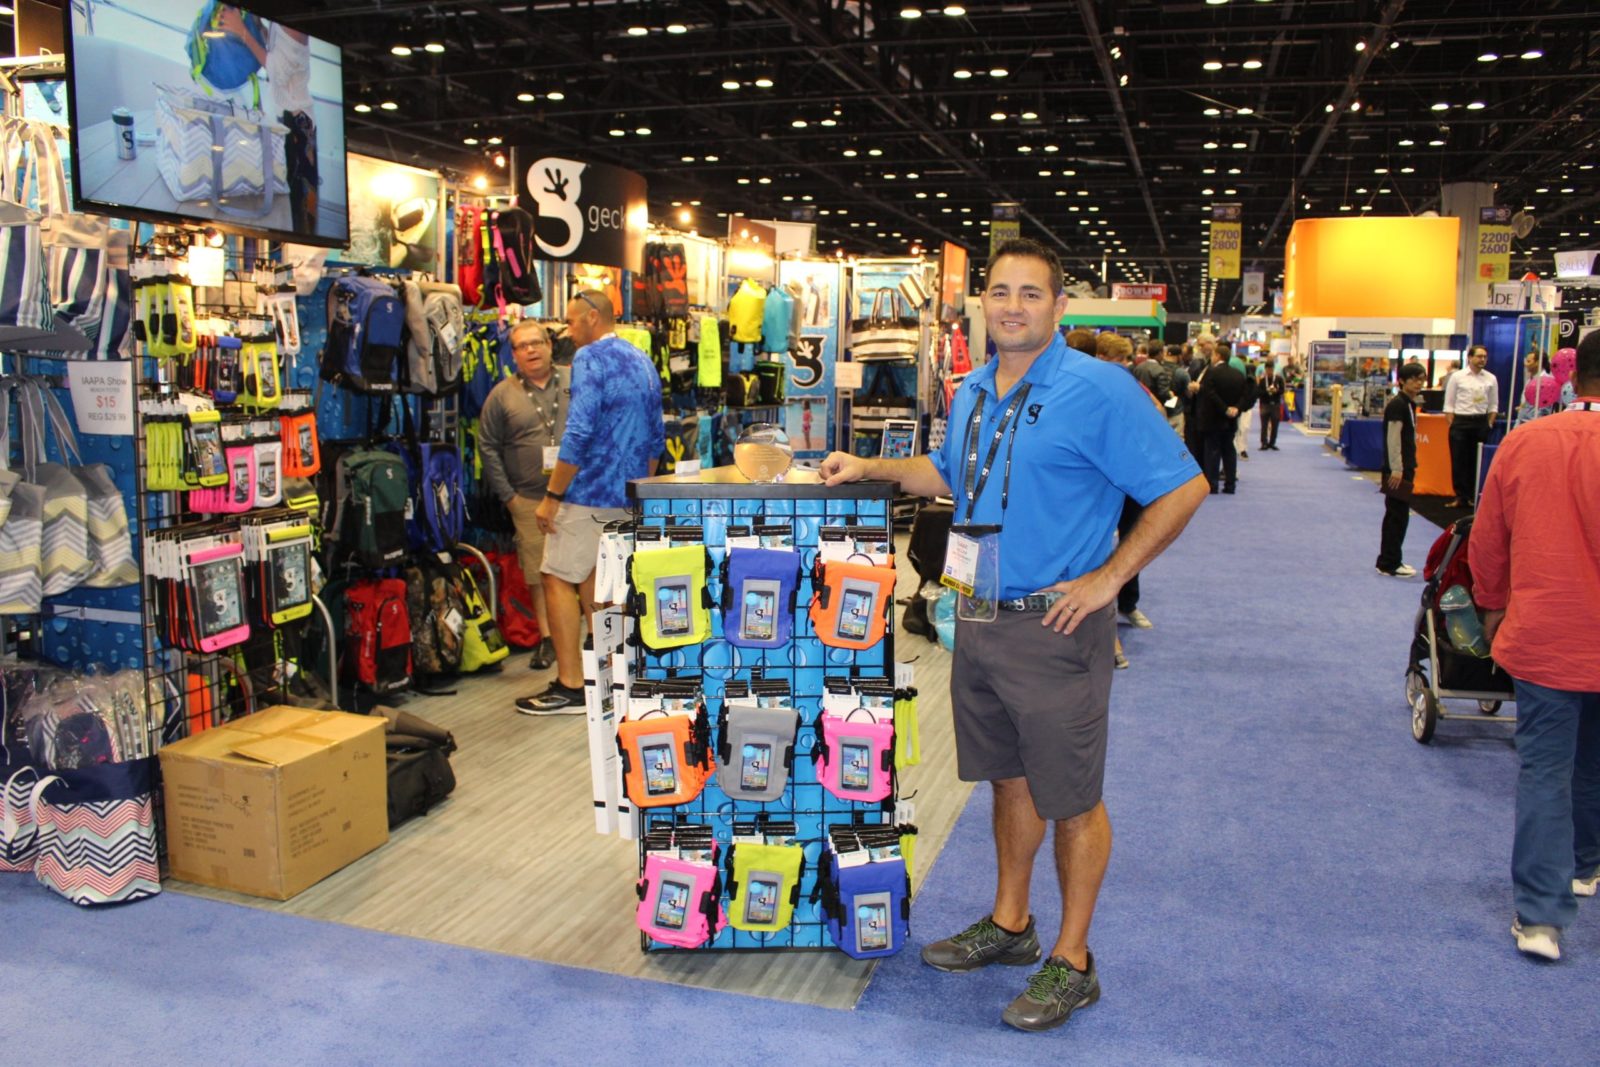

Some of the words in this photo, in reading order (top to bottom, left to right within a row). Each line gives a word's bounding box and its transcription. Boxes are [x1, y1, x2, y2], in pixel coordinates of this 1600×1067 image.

[1213, 229, 1239, 239] 2700
[1481, 232, 1509, 243] 2200
[1211, 240, 1237, 250] 2800
[1480, 243, 1507, 254] 2600
[107, 376, 127, 385] Show
[96, 395, 116, 408] $15
